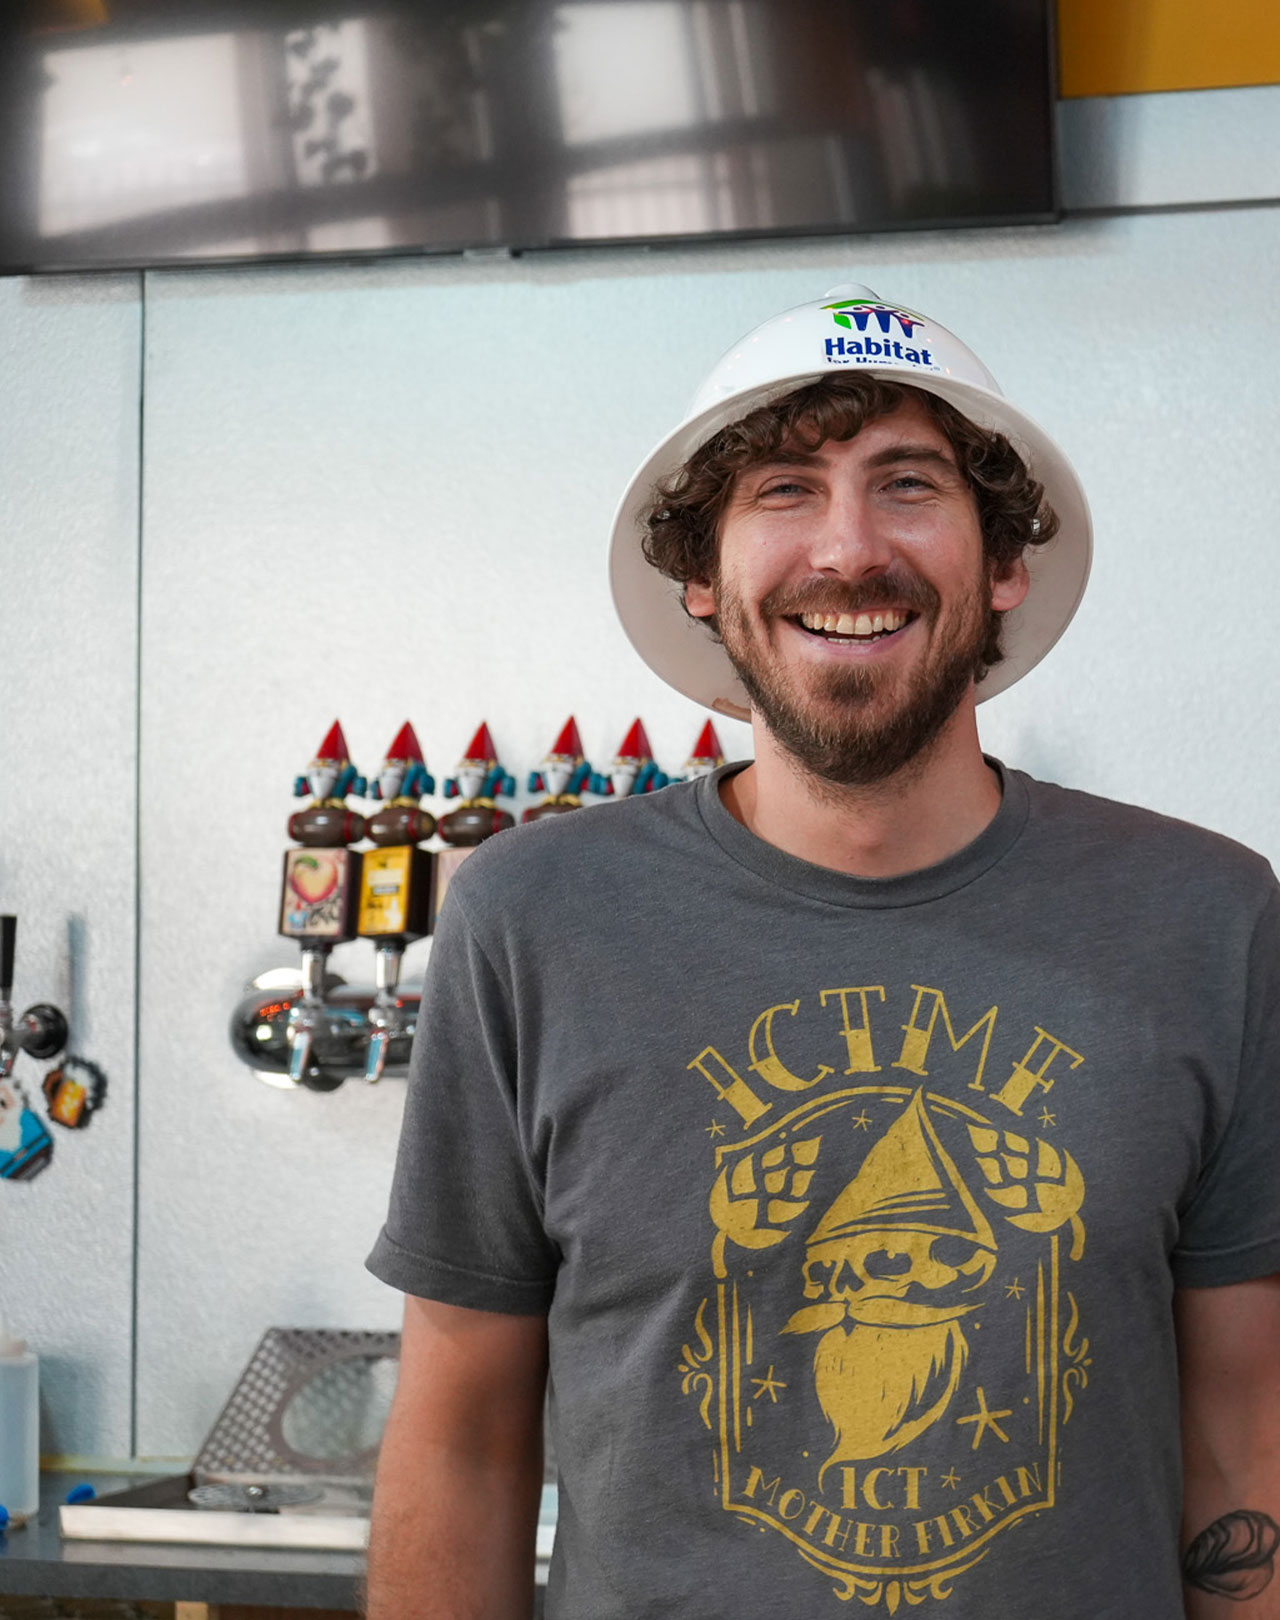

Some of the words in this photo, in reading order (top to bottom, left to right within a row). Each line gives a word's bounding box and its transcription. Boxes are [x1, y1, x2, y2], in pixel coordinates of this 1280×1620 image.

[824, 337, 932, 365] Habitat
[742, 1465, 902, 1558] MOTHER
[915, 1462, 1047, 1557] FIRKIN
[840, 1466, 928, 1511] ICT
